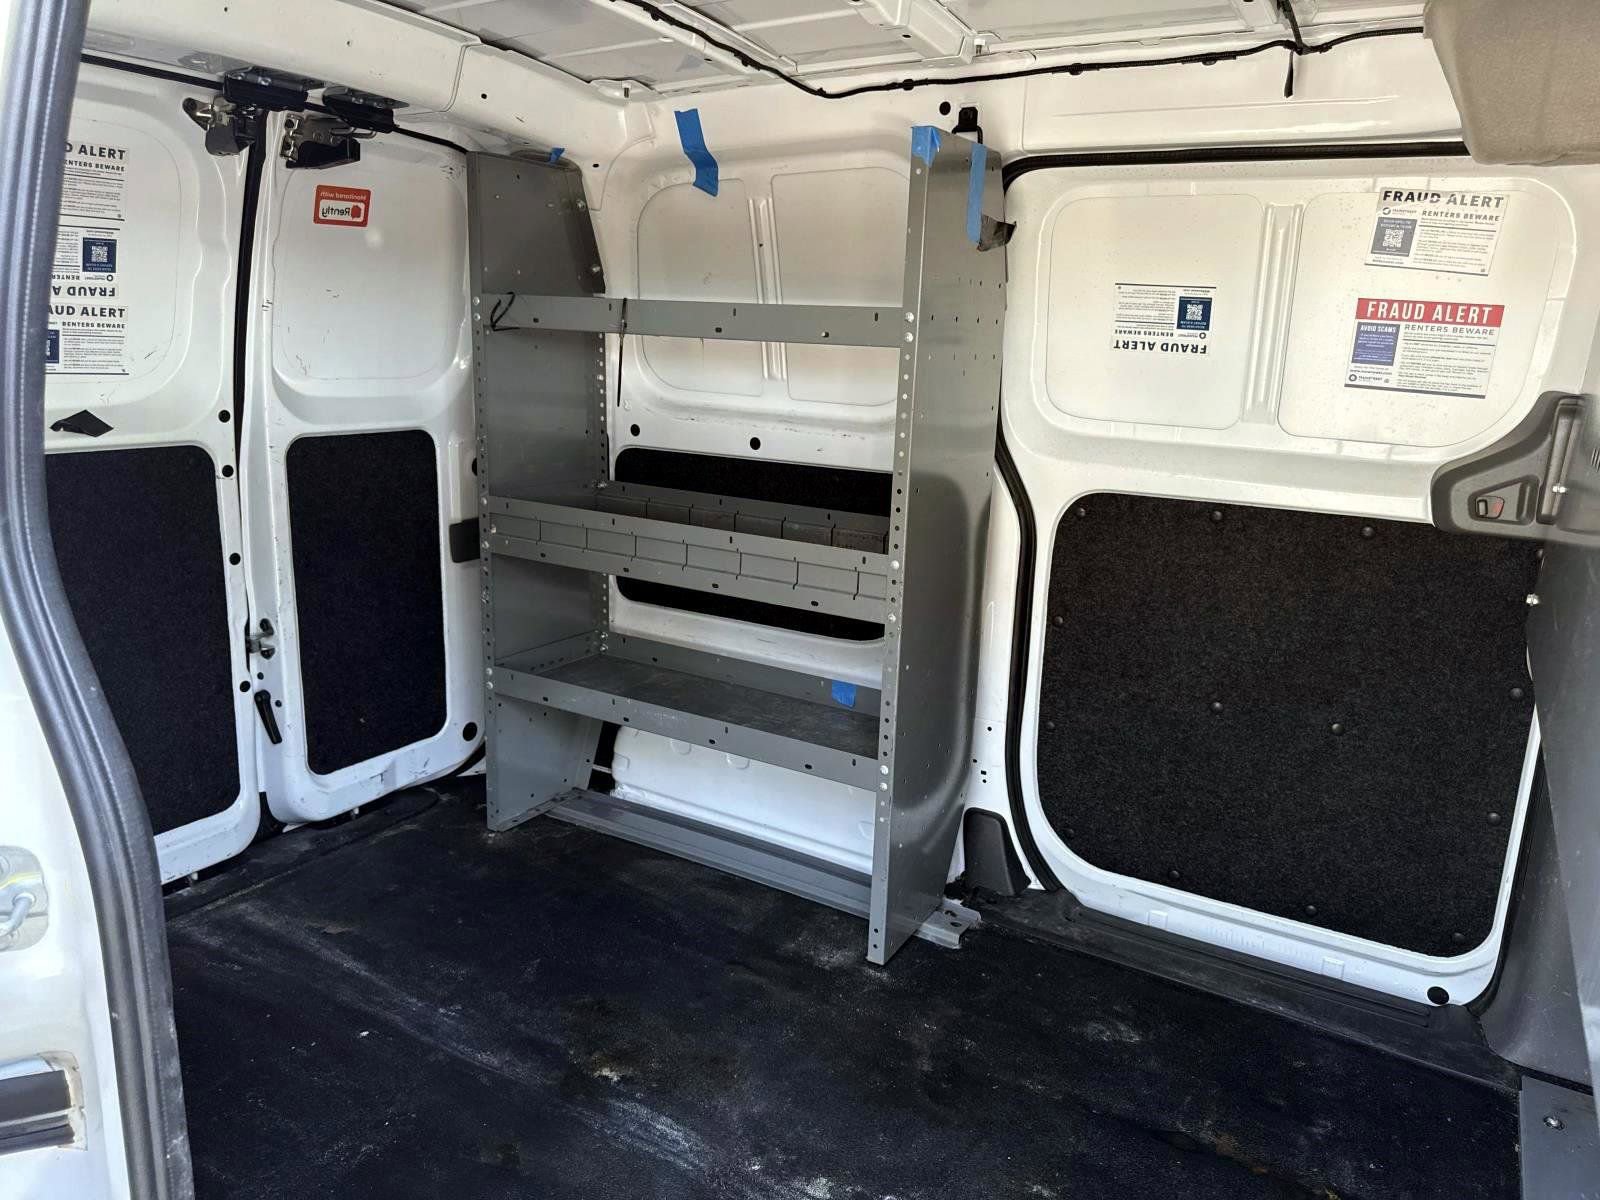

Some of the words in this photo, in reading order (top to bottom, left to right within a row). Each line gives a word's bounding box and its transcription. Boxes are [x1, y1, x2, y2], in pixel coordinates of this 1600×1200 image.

[78, 144, 126, 160] ALERT
[63, 159, 93, 168] ENTERS
[95, 163, 125, 172] BEWARE
[1382, 190, 1441, 204] FRAUD
[1446, 193, 1504, 208] ALERT
[1422, 210, 1461, 219] RENTERS
[1463, 213, 1500, 222] BEWARE
[67, 286, 116, 297] FRAUD
[48, 304, 76, 316] AUD
[80, 306, 126, 318] ALERT
[1367, 301, 1425, 320] FRAUD
[1432, 304, 1493, 324] ALERT
[1143, 330, 1174, 338] RENTERS
[1360, 324, 1377, 332] AVOID
[1404, 324, 1449, 333] RENTERS
[1452, 327, 1495, 336] BEWARE
[1113, 339, 1156, 351] ALERT
[1160, 342, 1207, 355] FRAUD
